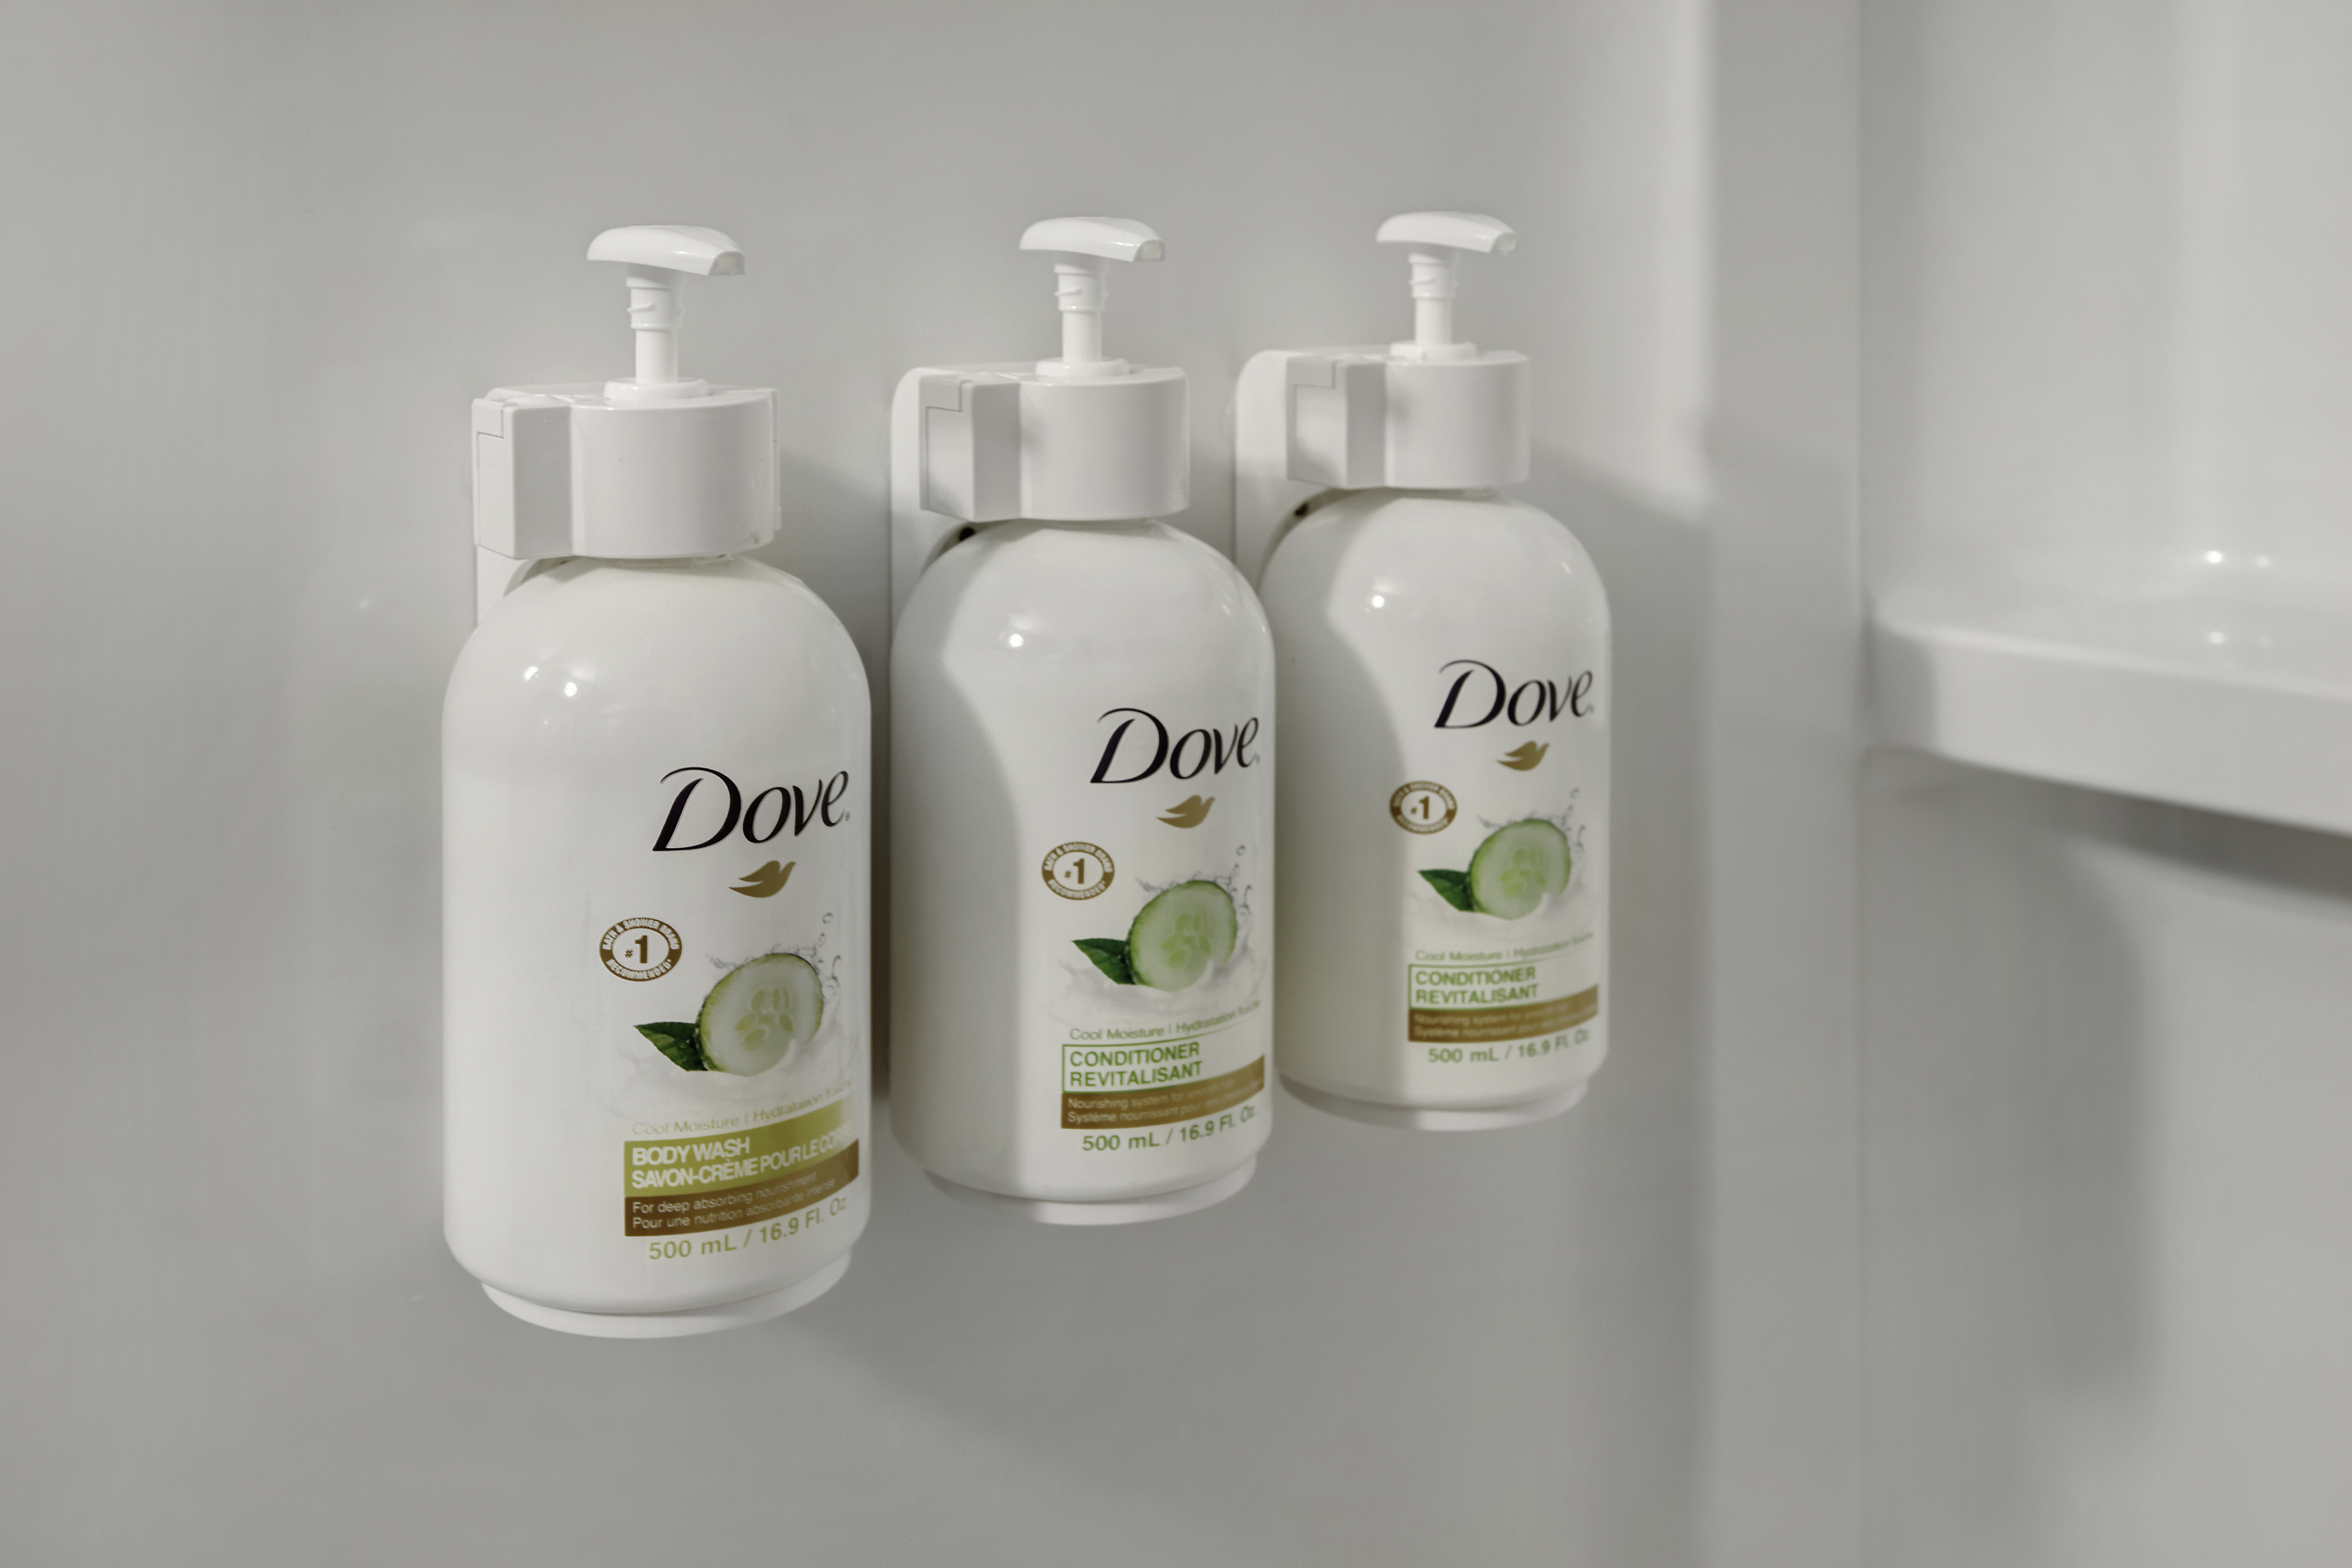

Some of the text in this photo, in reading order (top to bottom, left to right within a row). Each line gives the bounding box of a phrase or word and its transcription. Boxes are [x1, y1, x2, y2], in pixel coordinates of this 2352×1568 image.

[1434, 659, 1592, 729] Dove
[1090, 707, 1259, 784] Dove
[652, 766, 849, 852] Dove
[1415, 965, 1536, 986] CONDITIONER
[1415, 983, 1539, 1005] REVITALISANT
[1069, 1029, 1102, 1040] Cool
[1107, 1025, 1164, 1040] Moisture
[1069, 1041, 1200, 1067] CONDITIONER
[1429, 1048, 1463, 1062] 500
[1470, 1047, 1499, 1062] mL
[1069, 1060, 1203, 1087] REVITALISANT
[1068, 1098, 1129, 1111] Nourishing
[632, 1122, 668, 1136] Cool
[673, 1115, 740, 1134] Moisture
[1068, 1111, 1117, 1125] Système
[1082, 1135, 1120, 1152] 500
[1128, 1131, 1160, 1149] mL
[1179, 1120, 1214, 1141] 16.9
[631, 1158, 758, 1189] SAVON-CRÈME
[760, 1145, 802, 1173] POUR
[802, 1138, 819, 1160] LE
[632, 1136, 750, 1166] BODY WASH
[632, 1201, 655, 1214] For
[657, 1199, 690, 1214] deep
[694, 1190, 753, 1210] absorbing
[632, 1216, 663, 1229] Pour
[666, 1217, 690, 1227] une
[694, 1207, 743, 1225] nutrition
[649, 1240, 691, 1260] 500
[701, 1234, 737, 1254] mL
[760, 1217, 799, 1244] 16.9
[805, 1208, 824, 1229] Fl.
